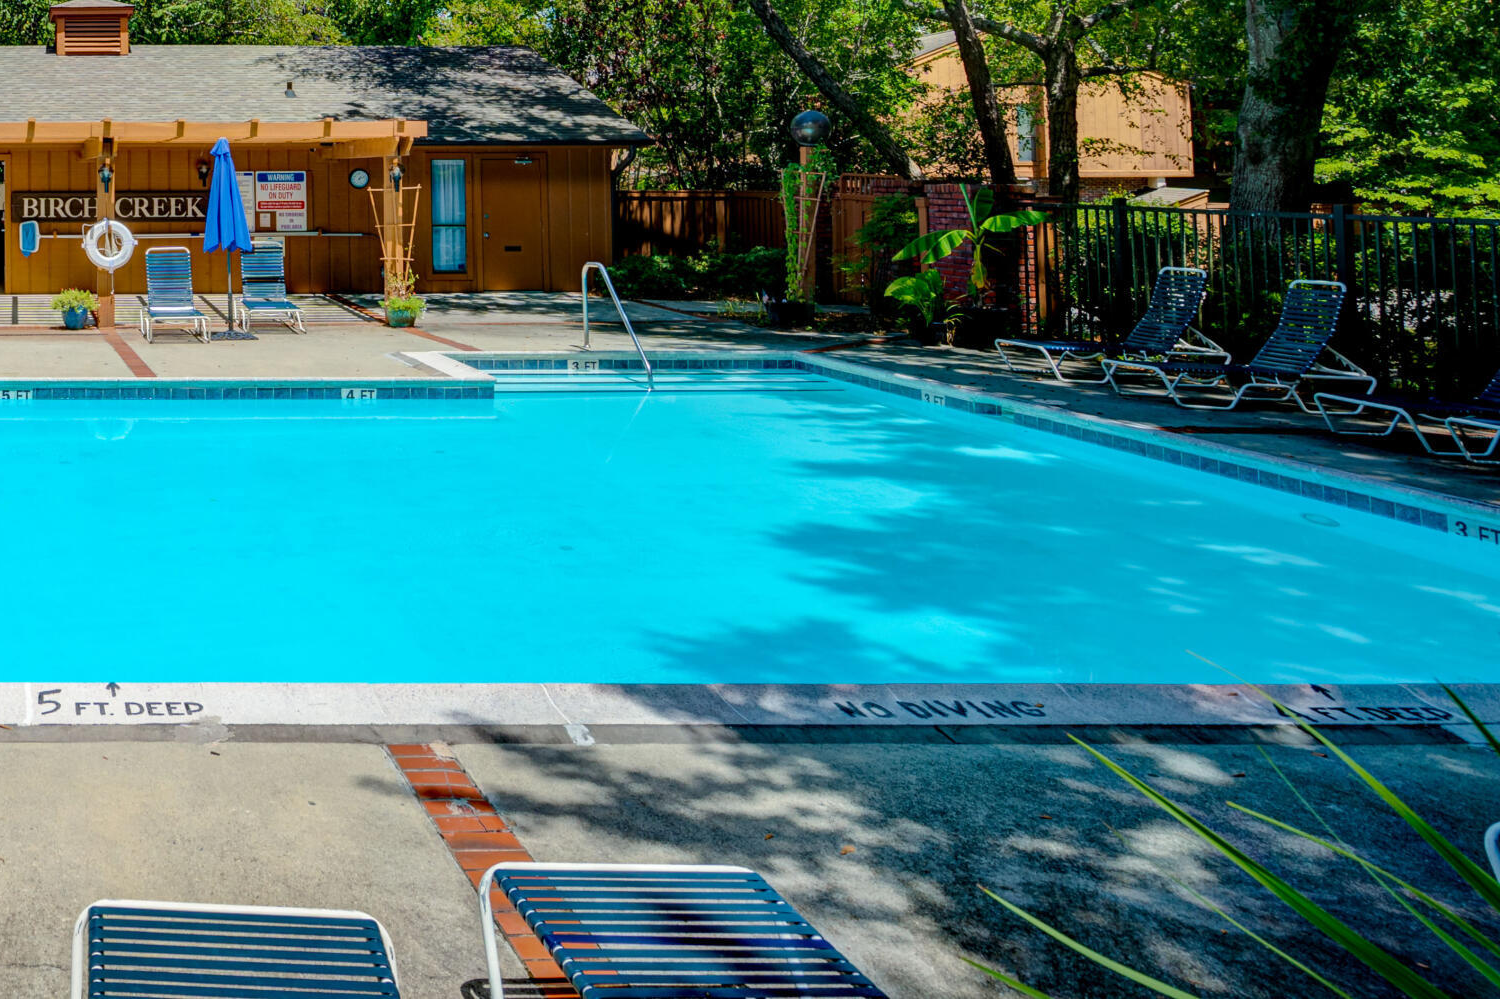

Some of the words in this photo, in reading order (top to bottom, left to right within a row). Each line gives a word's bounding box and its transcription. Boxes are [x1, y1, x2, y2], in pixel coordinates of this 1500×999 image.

[260, 183, 269, 191] NO
[270, 183, 302, 191] LIFEGUARD
[22, 197, 98, 218] BIRCH
[114, 197, 206, 218] CREEK
[571, 361, 579, 370] 3
[584, 361, 597, 370] FT
[2, 389, 11, 400] 5
[16, 389, 31, 400] FT
[346, 389, 356, 400] 4
[360, 389, 375, 400] FT
[933, 395, 944, 408] FT
[1455, 520, 1469, 537] 3
[1478, 526, 1500, 545] FT
[37, 689, 62, 715] 5
[74, 701, 115, 716] FT.
[124, 701, 204, 716] DEEP
[832, 700, 898, 719] NO
[895, 699, 1047, 720] DIVING
[1272, 702, 1319, 723] 4
[1356, 706, 1454, 721] DEEP
